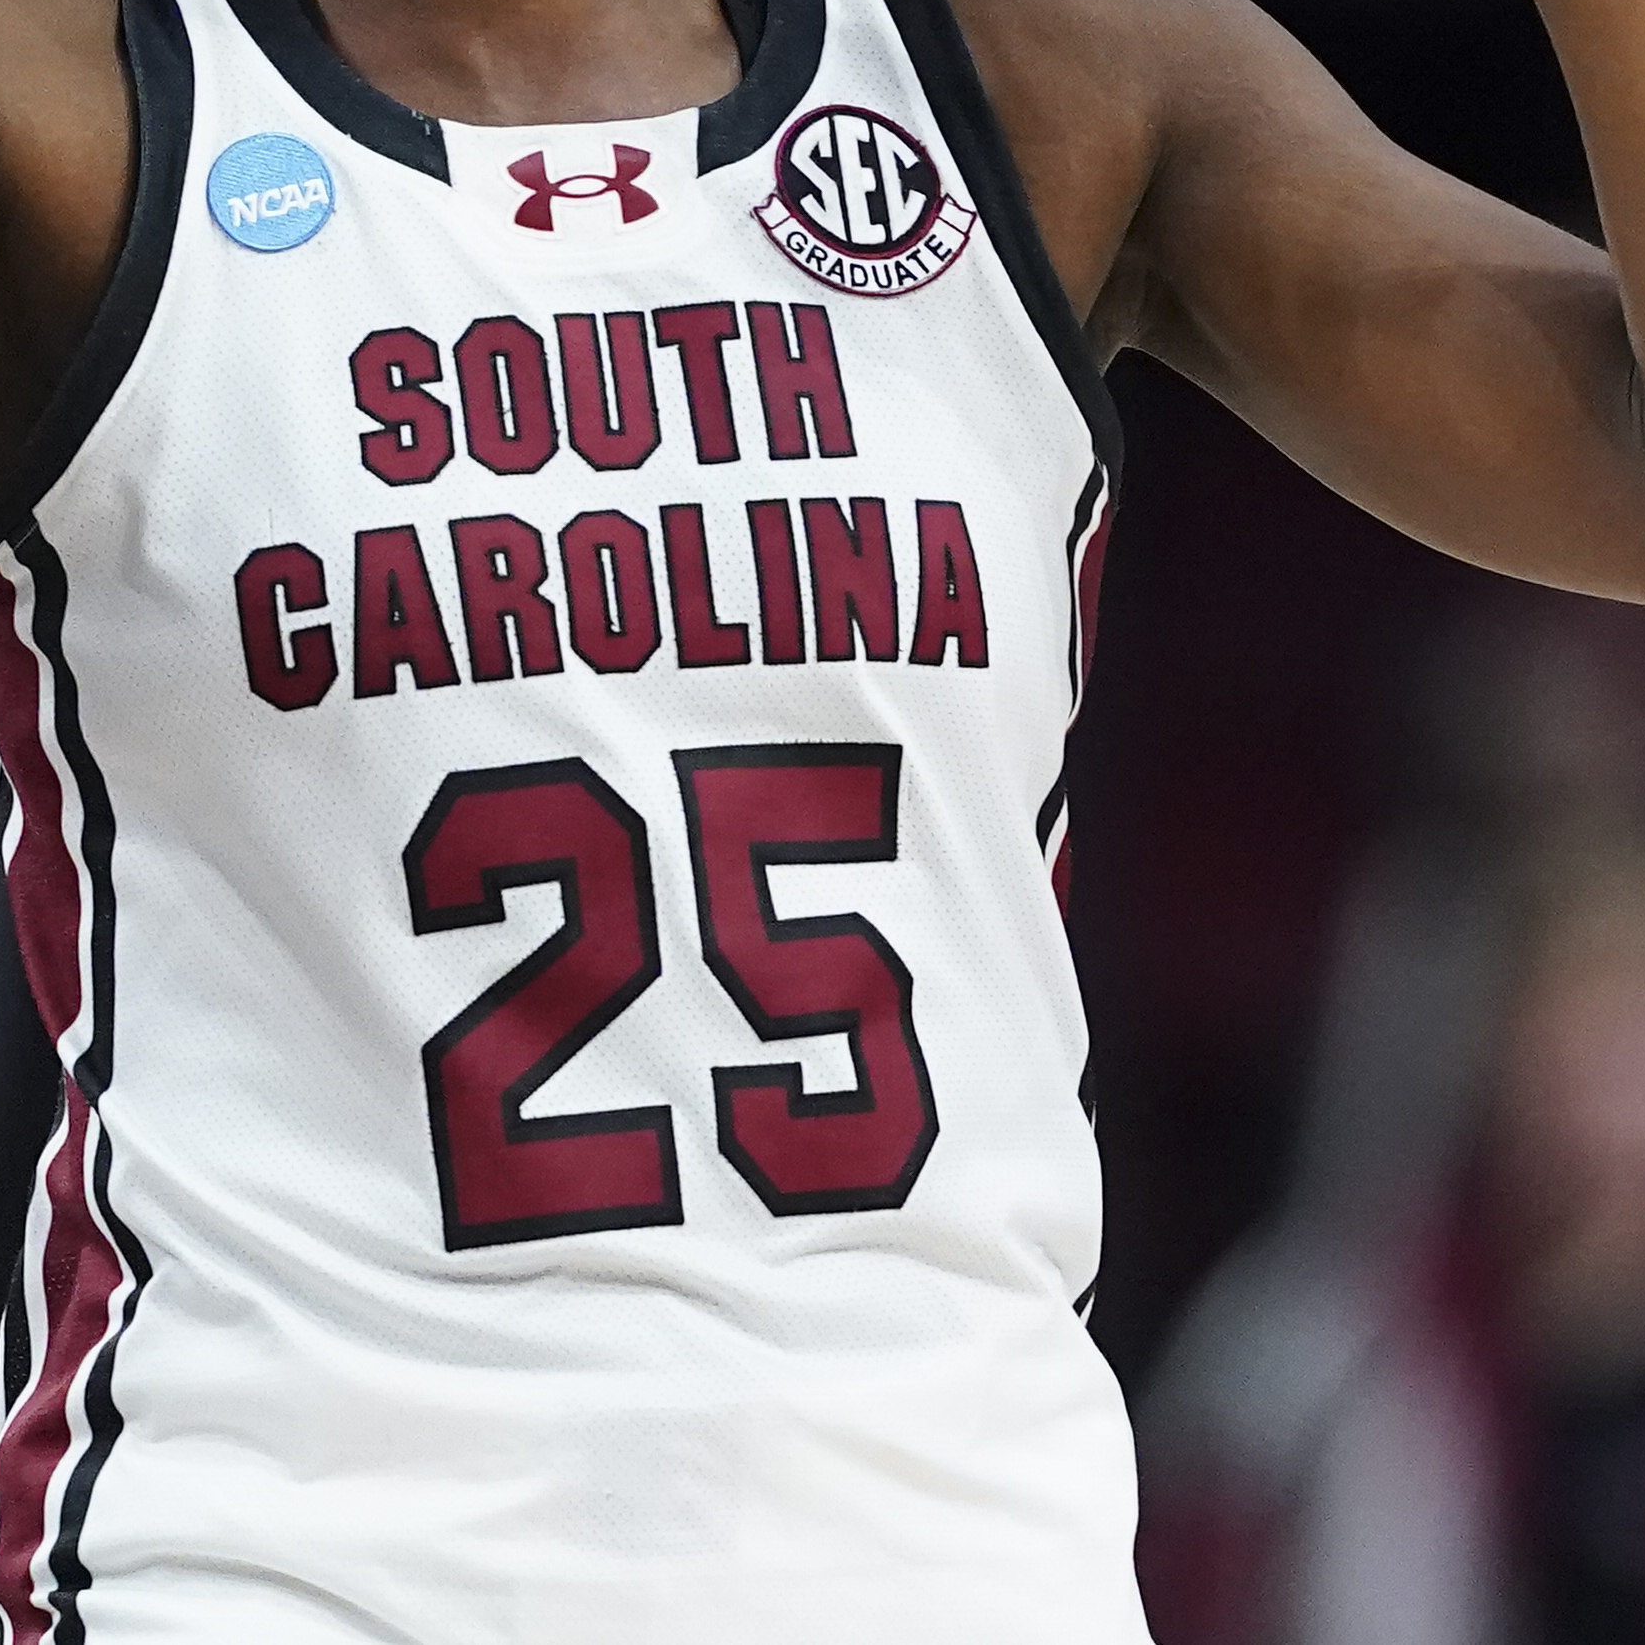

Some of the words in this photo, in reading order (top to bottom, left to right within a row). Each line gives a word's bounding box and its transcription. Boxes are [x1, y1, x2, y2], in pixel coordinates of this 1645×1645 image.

[227, 178, 329, 228] NCAA
[790, 115, 927, 245] SEC
[786, 231, 953, 288] GRADUATE
[349, 301, 857, 486] SOUTH
[234, 497, 989, 711] CAROLINA
[402, 742, 939, 1252] 25
